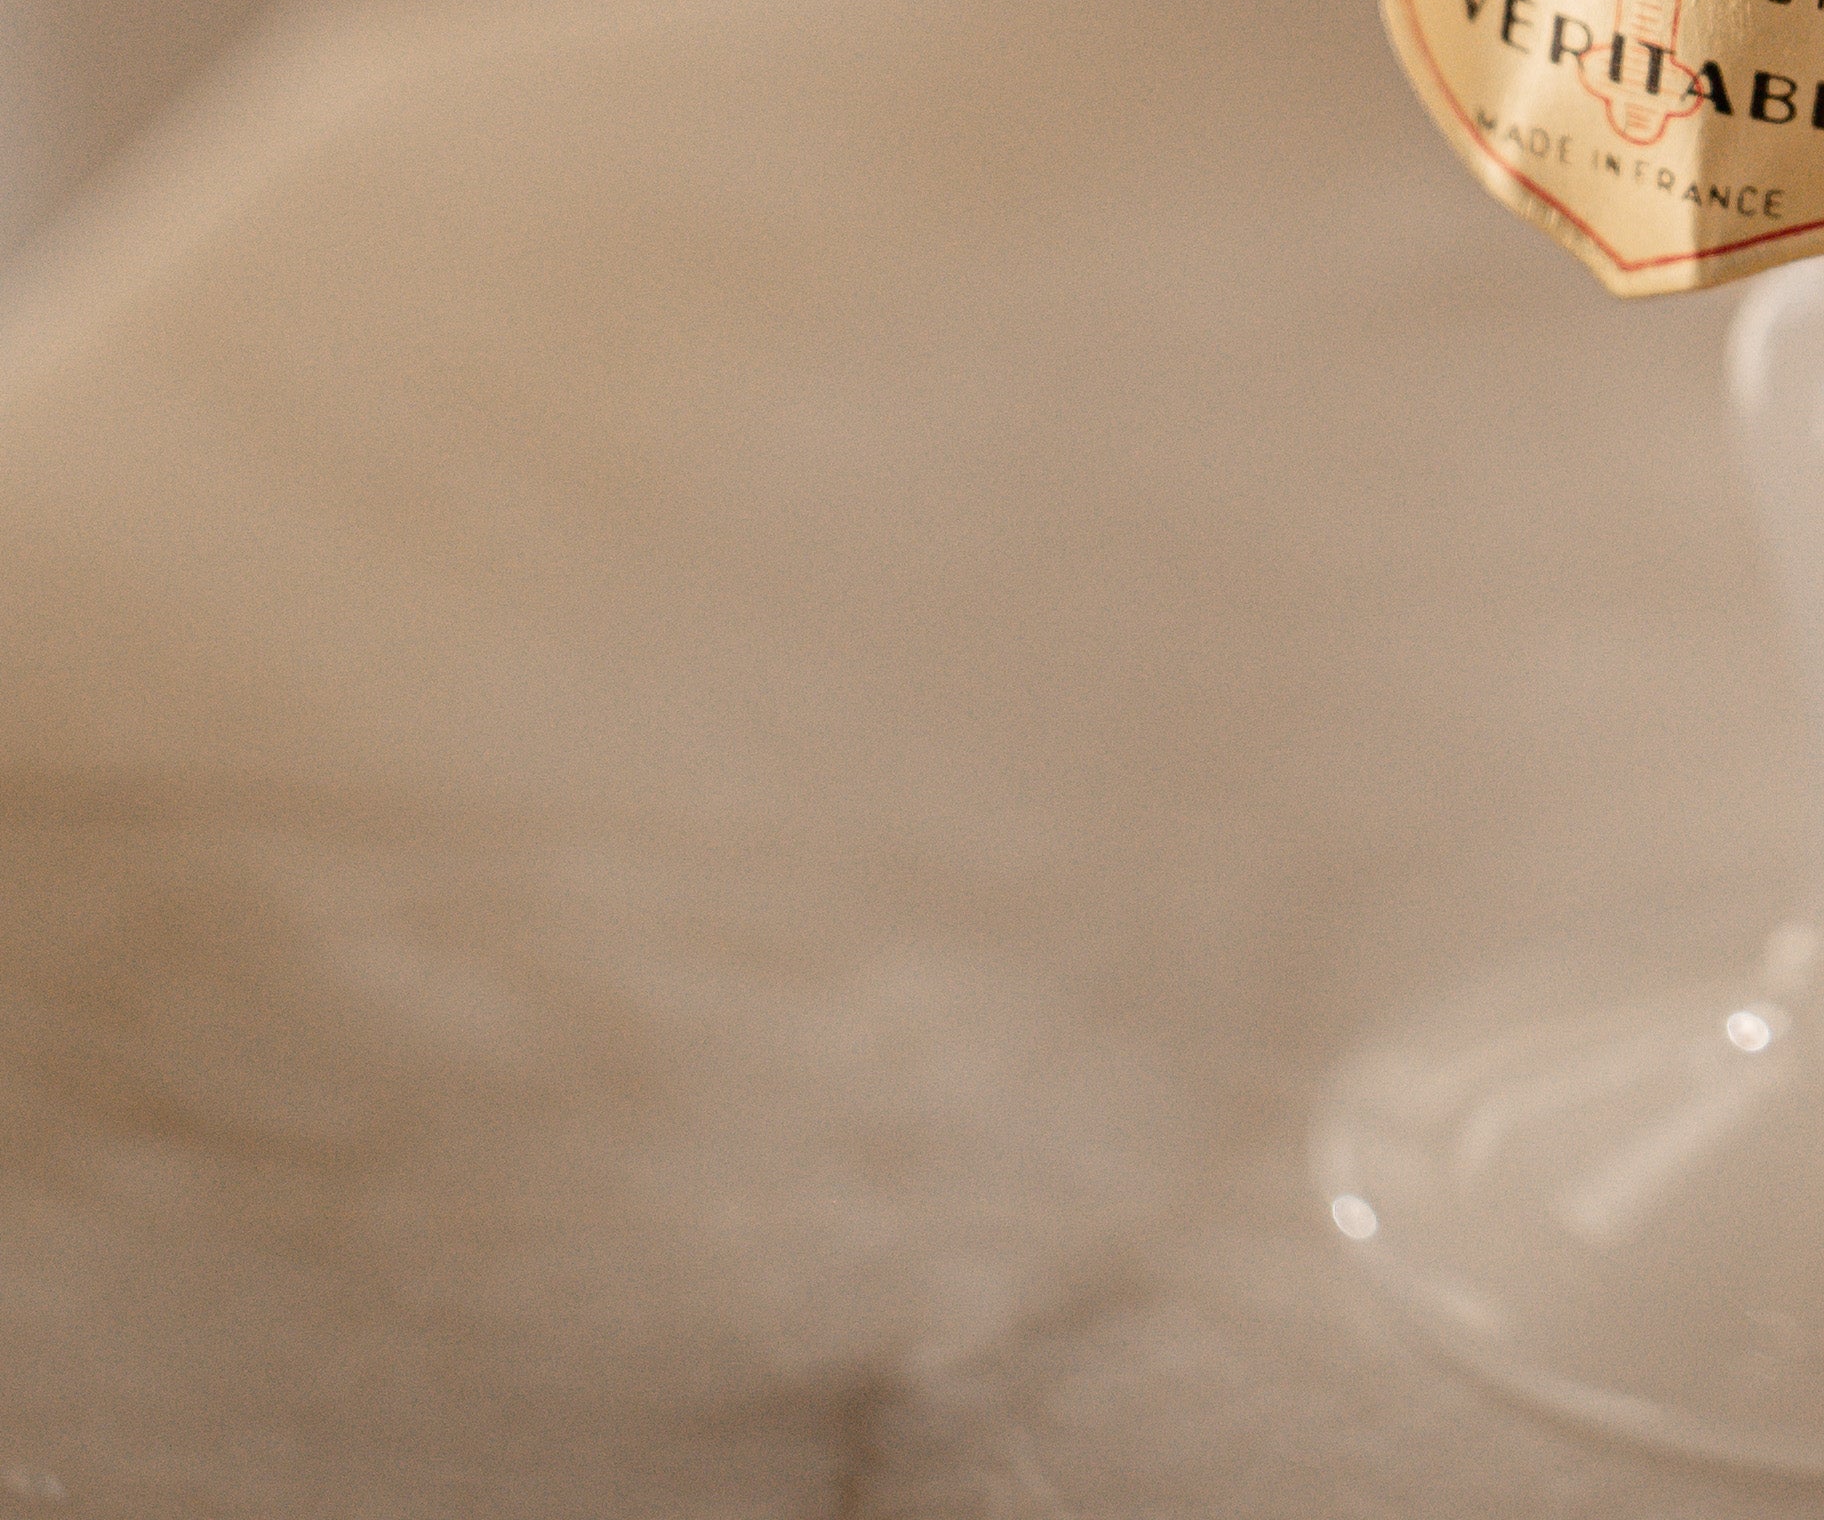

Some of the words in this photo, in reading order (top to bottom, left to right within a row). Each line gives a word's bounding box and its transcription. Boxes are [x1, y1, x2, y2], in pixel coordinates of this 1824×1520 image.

[1475, 106, 1575, 166] MADE
[1592, 152, 1623, 178] IN
[1631, 160, 1786, 221] FRANCE
